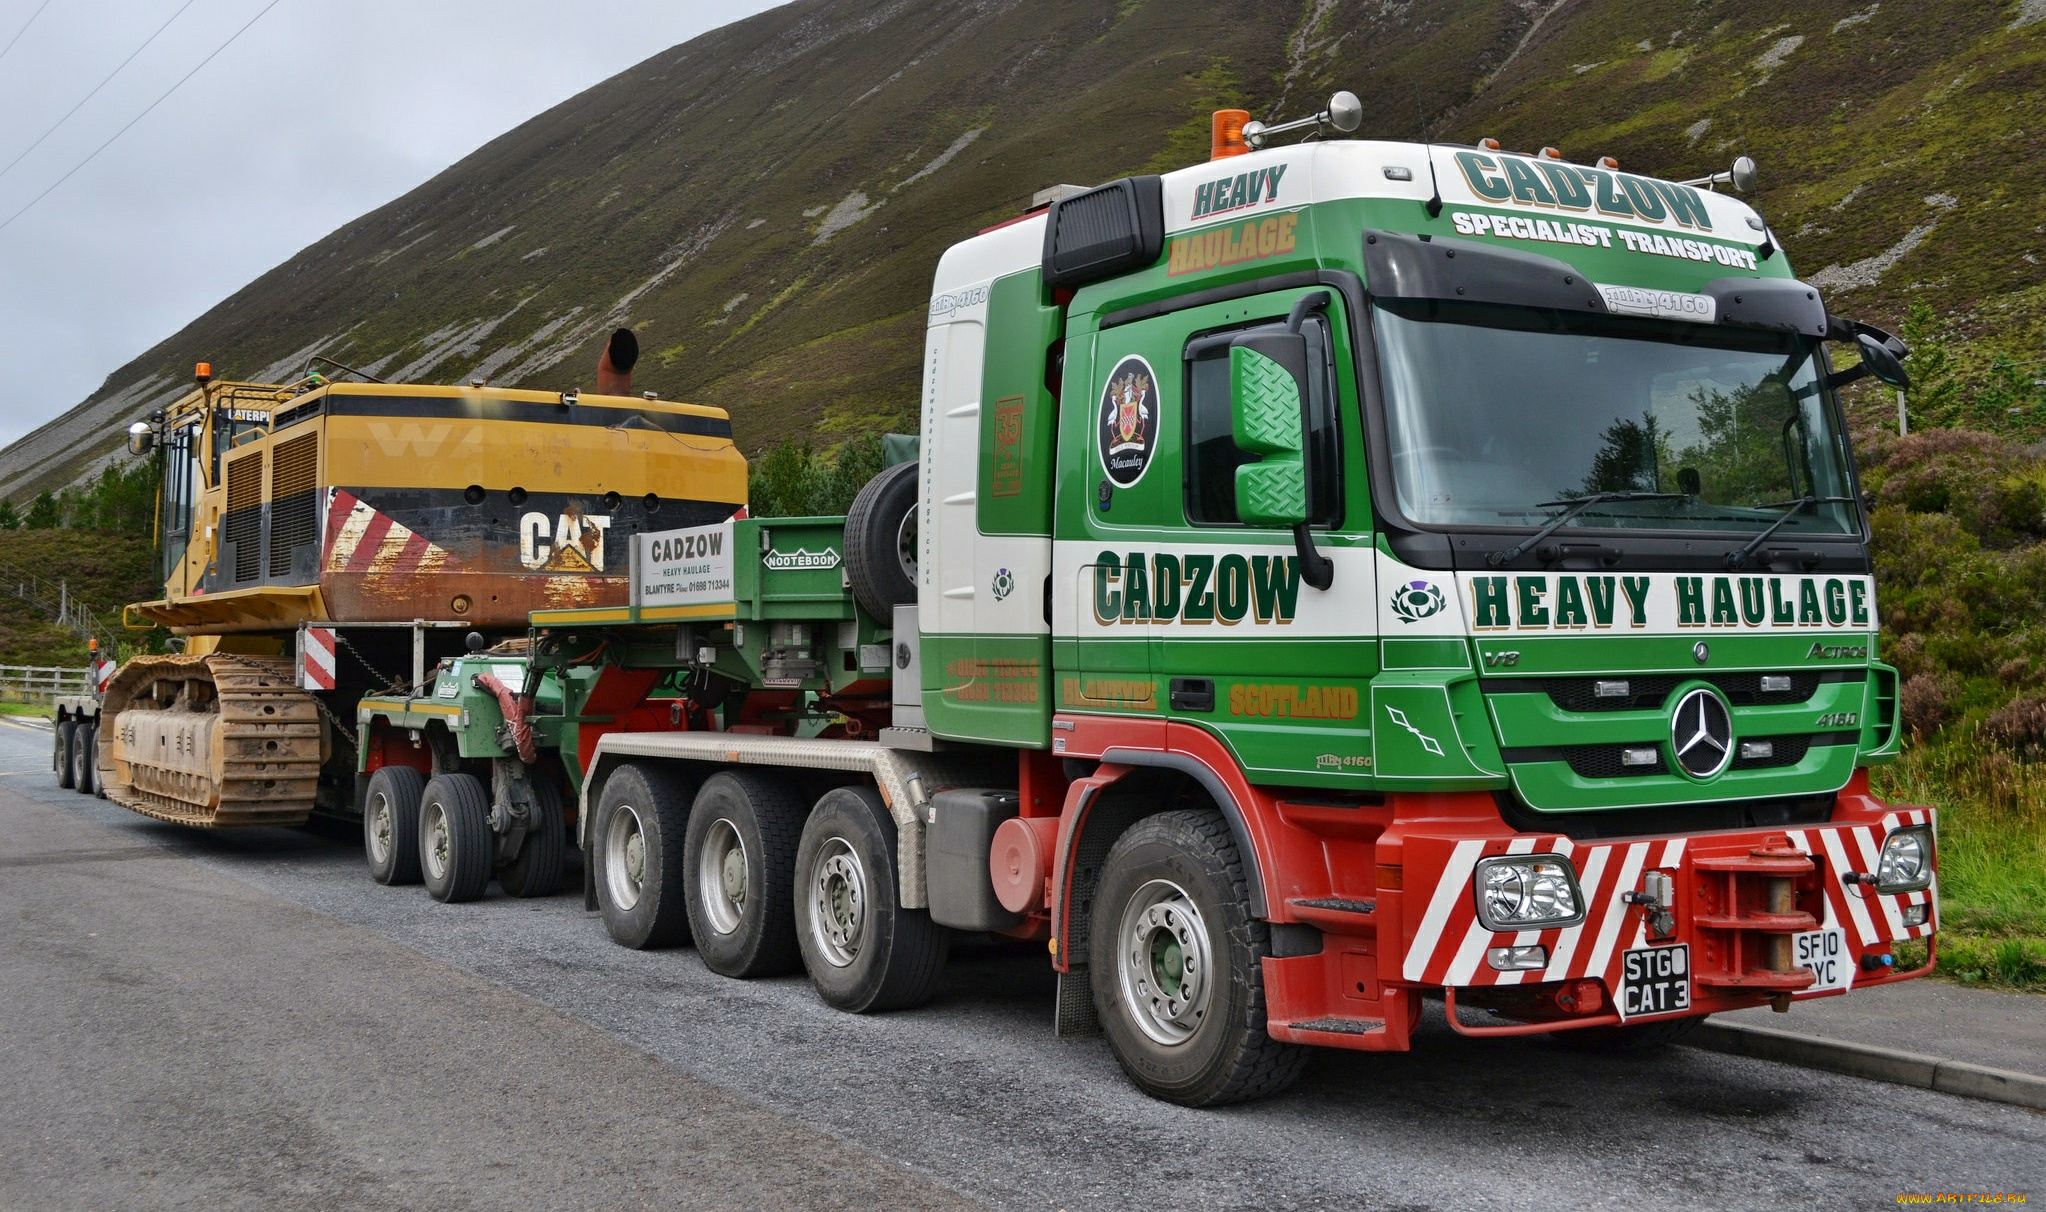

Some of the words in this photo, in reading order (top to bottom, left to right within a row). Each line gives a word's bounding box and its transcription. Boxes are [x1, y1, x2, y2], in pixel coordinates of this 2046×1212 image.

[1190, 163, 1288, 221] HEAVY
[1453, 151, 1713, 232] CADZOW
[1168, 213, 1299, 277] HAULAGE
[1451, 211, 1612, 248] SPECIALIST
[1616, 229, 1758, 271] TRANSPORT
[957, 286, 988, 308] 4160
[1658, 293, 1709, 314] 4160
[520, 511, 610, 572] CAT
[651, 532, 723, 563] CADZOW
[662, 567, 682, 577] HEAVY
[683, 565, 711, 575] HAULAGE
[768, 555, 835, 567] NOOTEBOOM
[645, 583, 675, 596] BLANTYRE
[1093, 549, 1302, 627] CADZOW
[1469, 575, 1650, 631] HEAVY
[1673, 577, 1869, 628] HAULAGE
[1485, 651, 1520, 667] V8
[1229, 683, 1359, 720] SCOTLAND
[1342, 755, 1372, 767] 4160
[1799, 931, 1838, 960] SF10
[1625, 982, 1669, 1014] CAT
[1674, 980, 1688, 1007] 3
